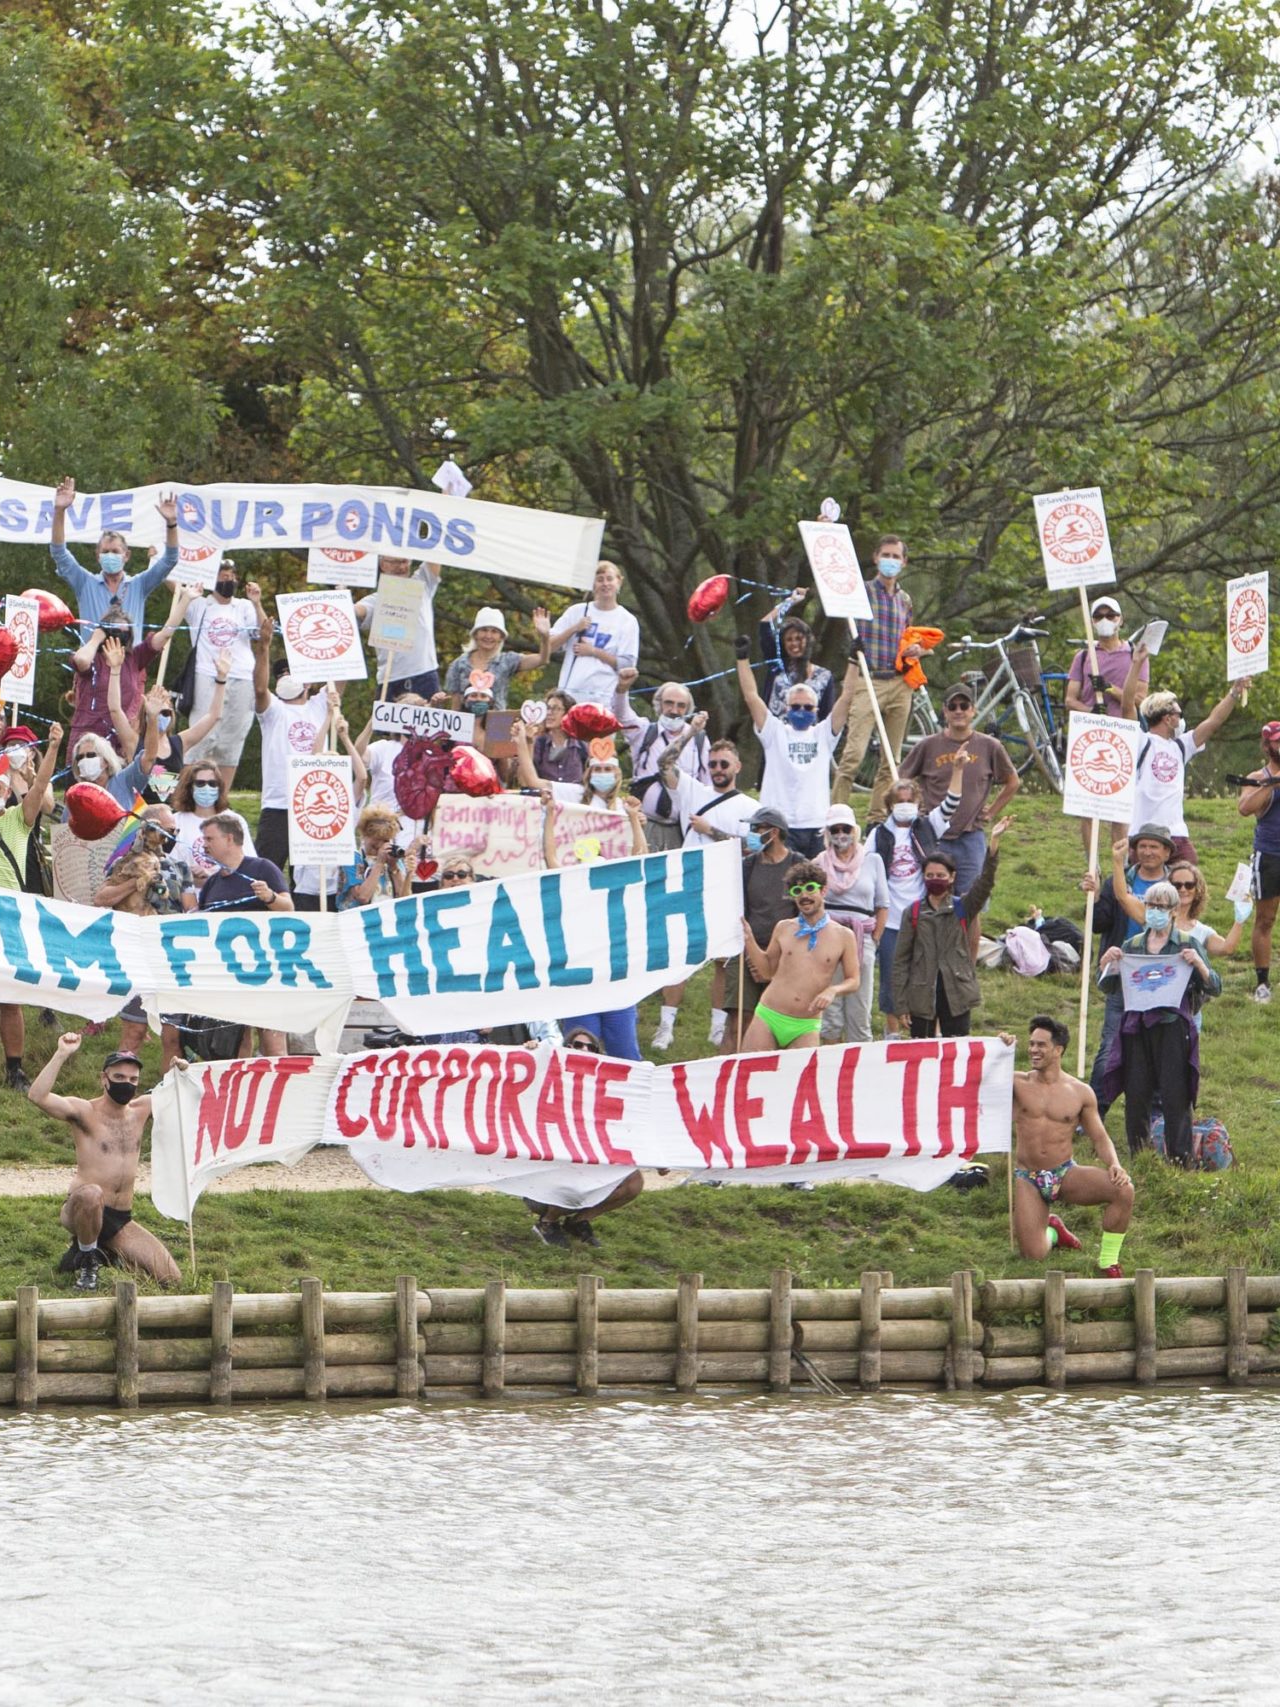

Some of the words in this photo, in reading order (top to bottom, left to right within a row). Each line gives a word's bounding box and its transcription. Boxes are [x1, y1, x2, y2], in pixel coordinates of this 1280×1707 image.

[1055, 504, 1077, 518] OUR
[176, 492, 288, 539] OUR
[300, 499, 476, 556] PONDS
[324, 548, 356, 561] ORUM
[1050, 546, 1089, 563] FORUM
[281, 593, 347, 605] @SaveOurPonds
[288, 613, 304, 640] SAVE
[300, 605, 324, 617] OUR
[325, 606, 352, 636] PONDS
[295, 643, 337, 659] FORUM
[413, 709, 440, 728] HAS
[1074, 715, 1136, 731] @SaveOurPonds
[1072, 736, 1089, 765] SAVE
[1088, 731, 1112, 743] OUR
[1112, 737, 1132, 772] PONDS
[291, 759, 348, 768] @SaveOurPonds
[1076, 768, 1113, 794] FORUM
[295, 781, 307, 812] SAVE
[307, 772, 327, 784] OUR
[328, 775, 348, 811] PONDS
[299, 817, 334, 838] FORUM
[159, 917, 333, 989] FOR
[361, 849, 708, 999] HEALTH
[195, 1056, 313, 1165] NOT
[335, 1047, 636, 1166] CORPORATE
[672, 1041, 985, 1169] WEALTH
